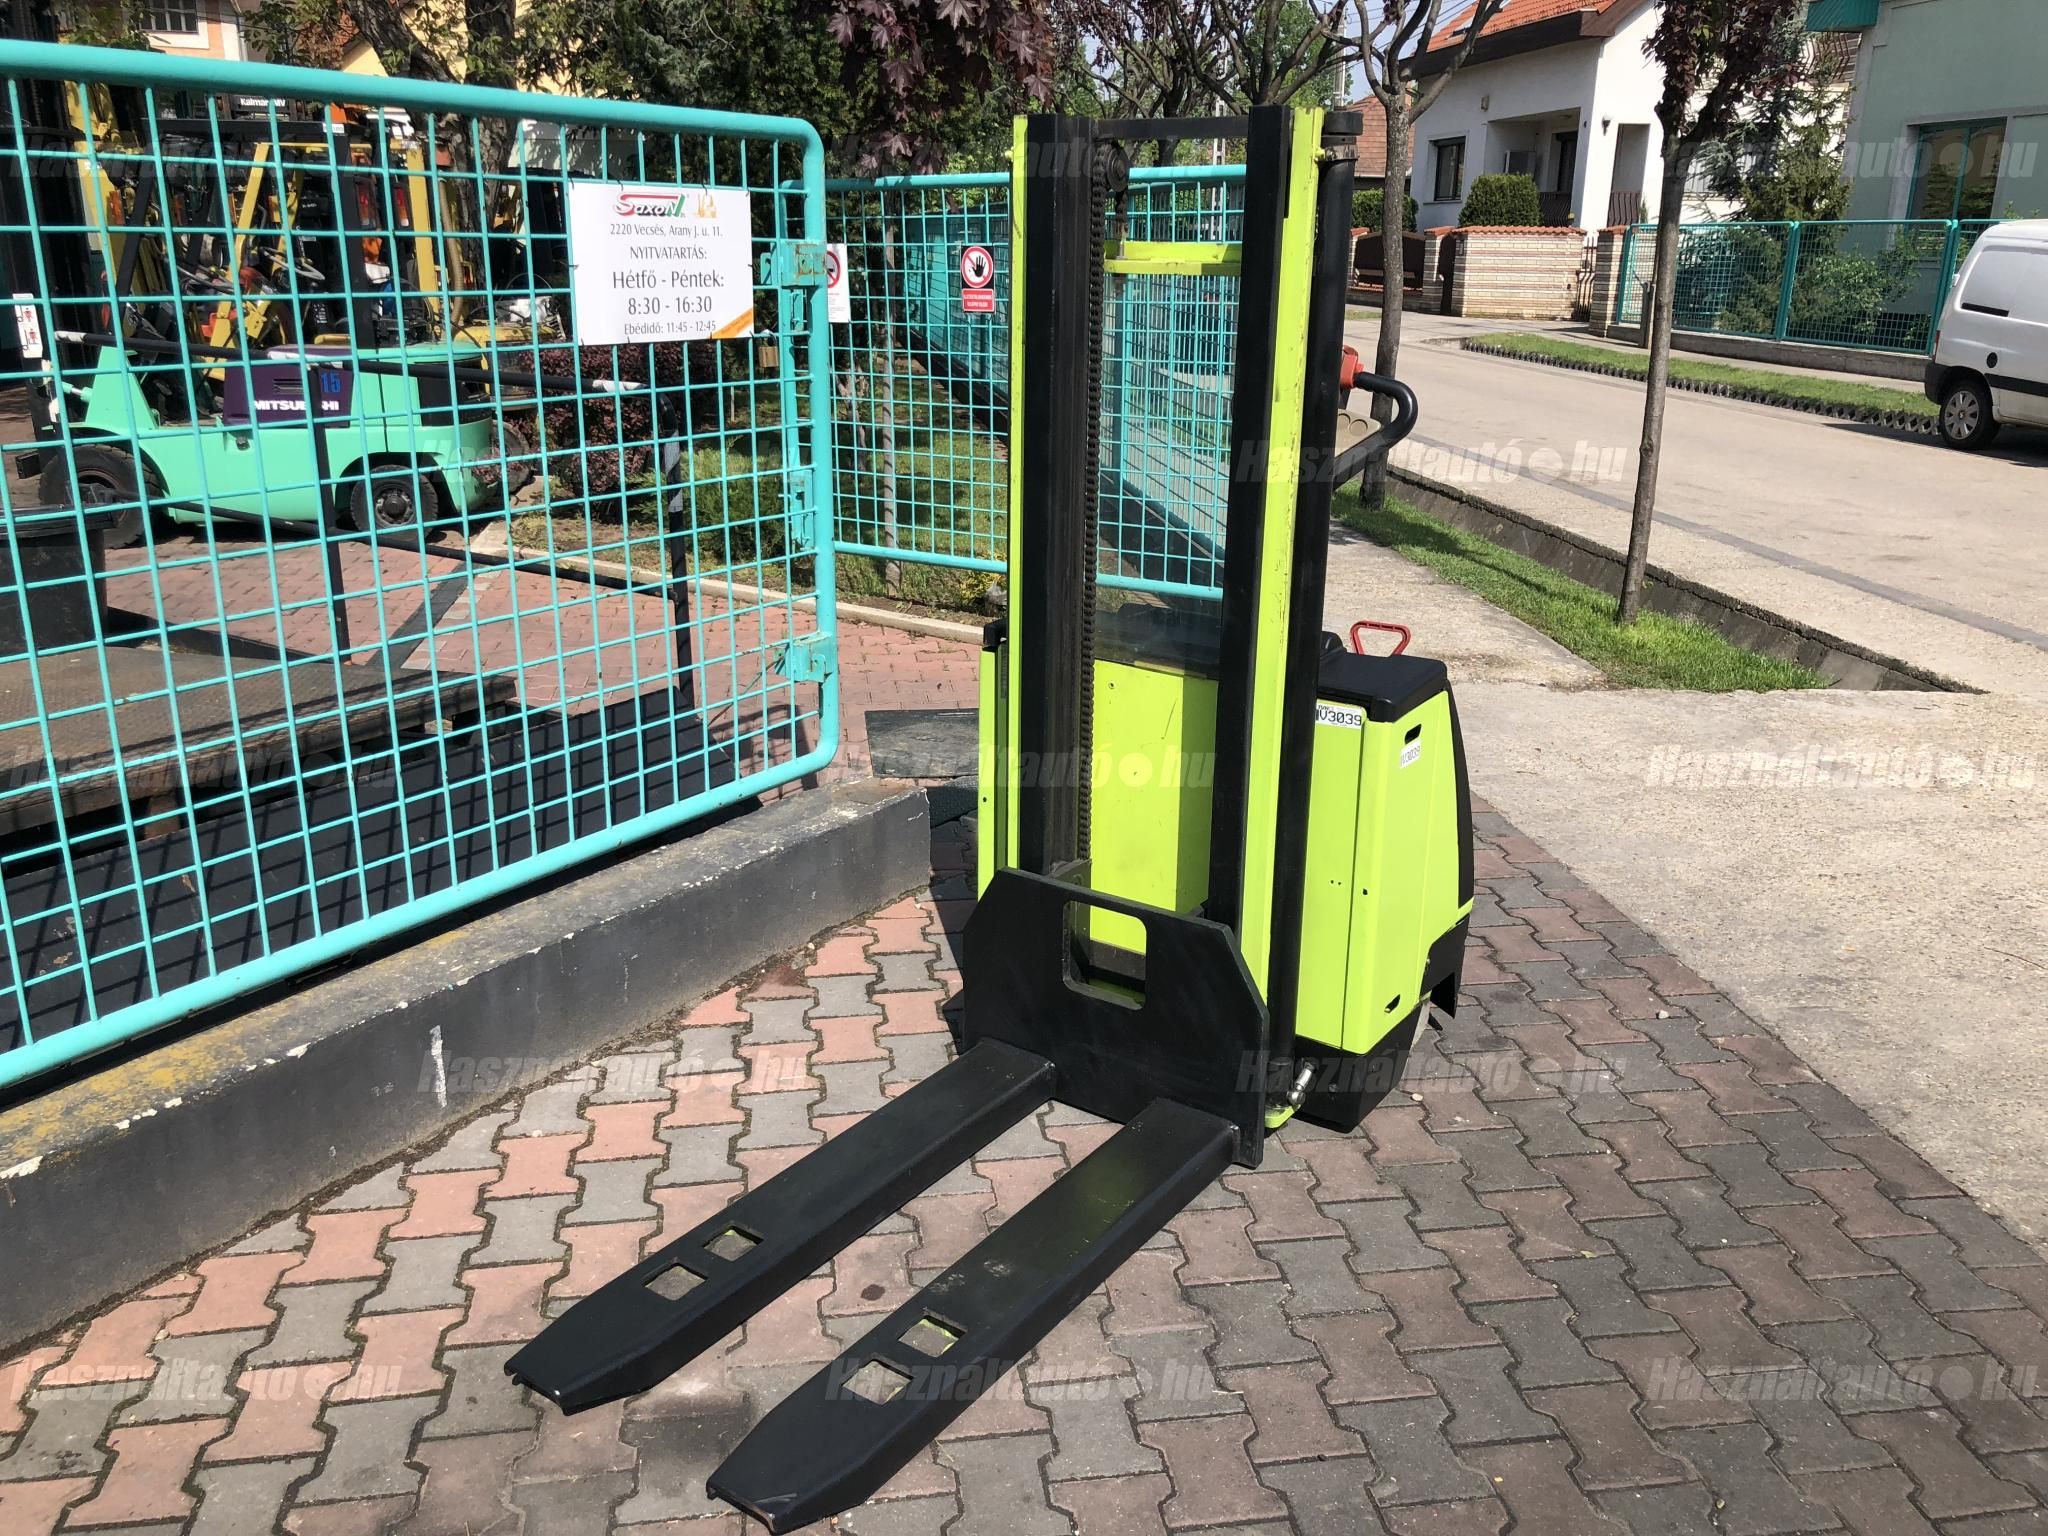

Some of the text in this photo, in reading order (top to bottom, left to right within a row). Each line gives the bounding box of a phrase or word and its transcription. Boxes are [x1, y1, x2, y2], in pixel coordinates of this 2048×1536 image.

[240, 97, 269, 107] Kalmar
[610, 223, 632, 236] 2220
[634, 222, 666, 237] Vecsés,
[669, 225, 692, 238] Arany
[630, 244, 707, 260] NYITVATARTÁS:
[613, 269, 657, 289] Hétfő
[671, 269, 724, 289] Péntek:
[628, 296, 661, 316] 8:30
[675, 295, 712, 314] 16:30
[666, 321, 688, 334] 11:45
[695, 320, 716, 332] 12:45
[321, 371, 342, 394] 15
